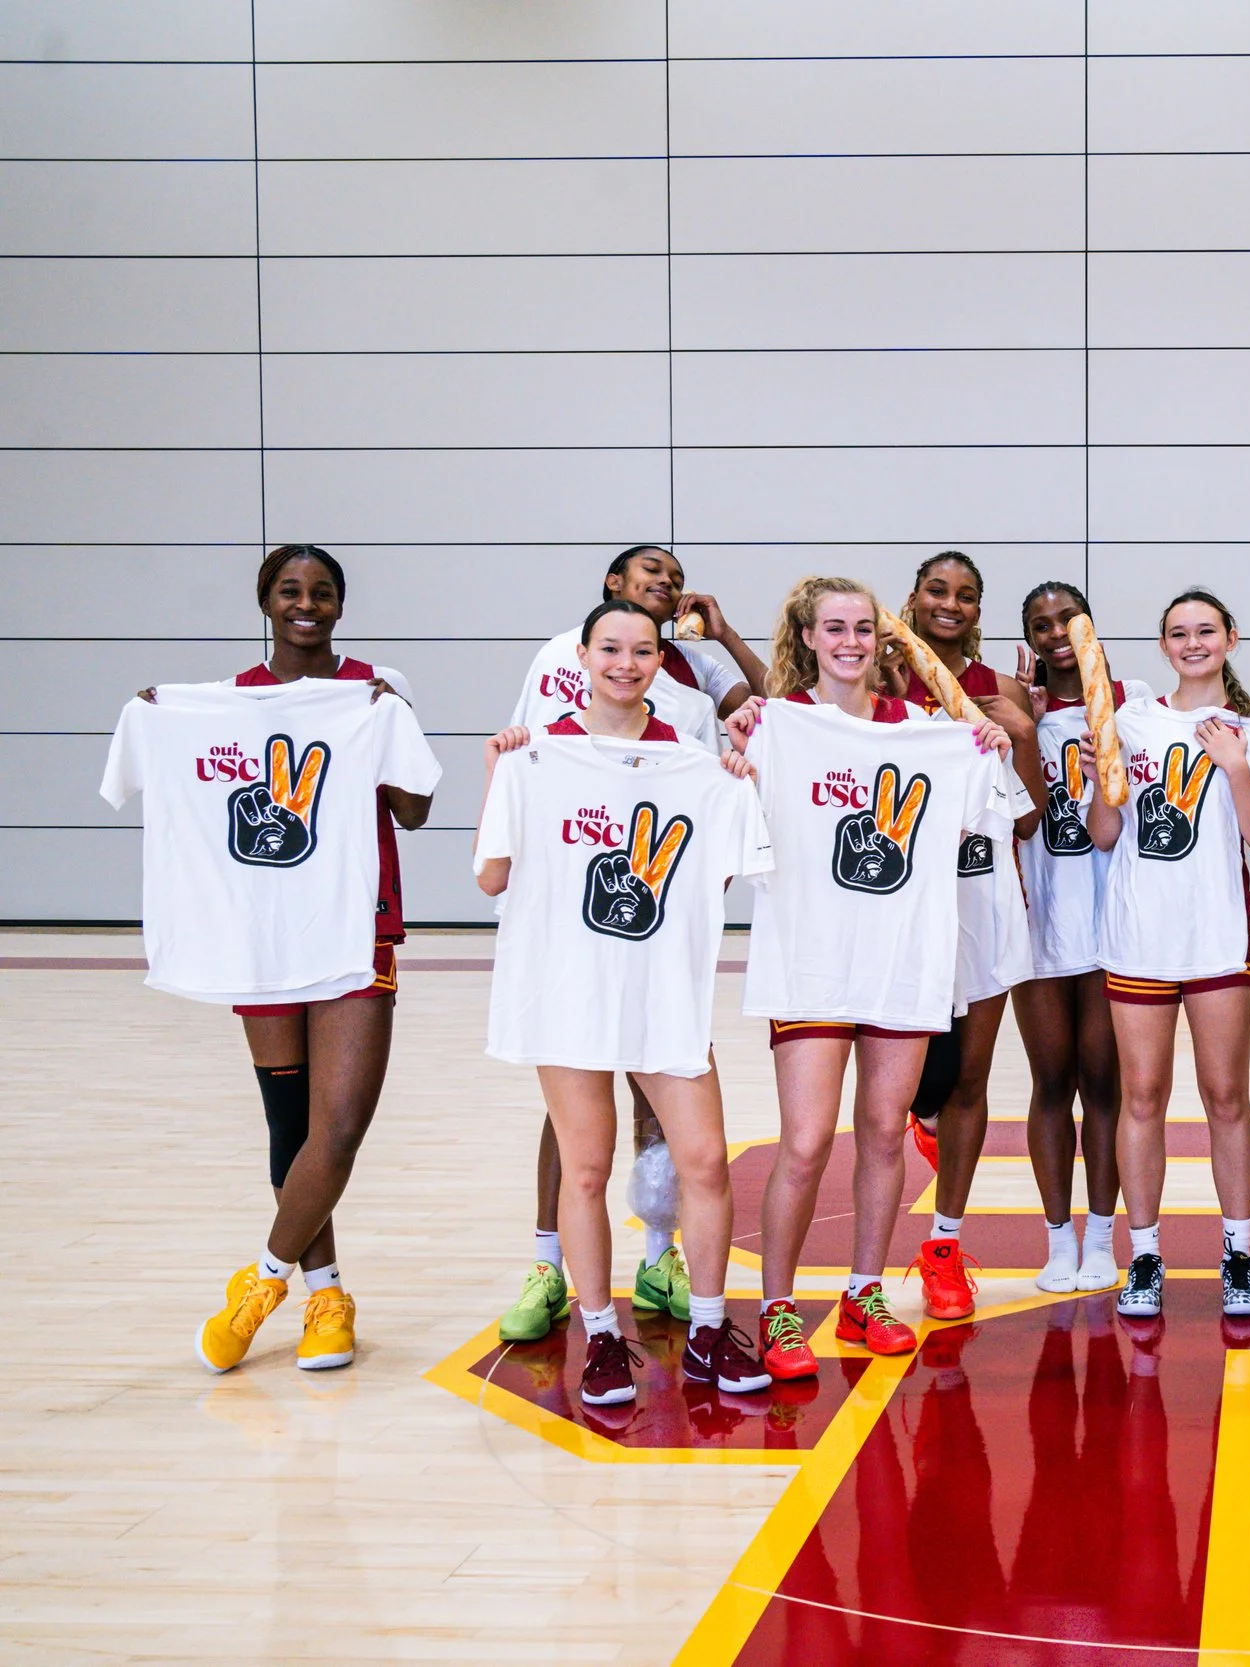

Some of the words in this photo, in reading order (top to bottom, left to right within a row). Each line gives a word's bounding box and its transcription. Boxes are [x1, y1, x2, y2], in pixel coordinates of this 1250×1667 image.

[557, 667, 583, 687] oui,
[540, 674, 592, 710] USC
[209, 742, 243, 758] oui,
[1130, 748, 1149, 763] oui,
[196, 758, 260, 782] USC
[826, 768, 856, 785] oui,
[812, 782, 868, 809] USC
[578, 805, 610, 823] oui,
[562, 819, 624, 847] USC
